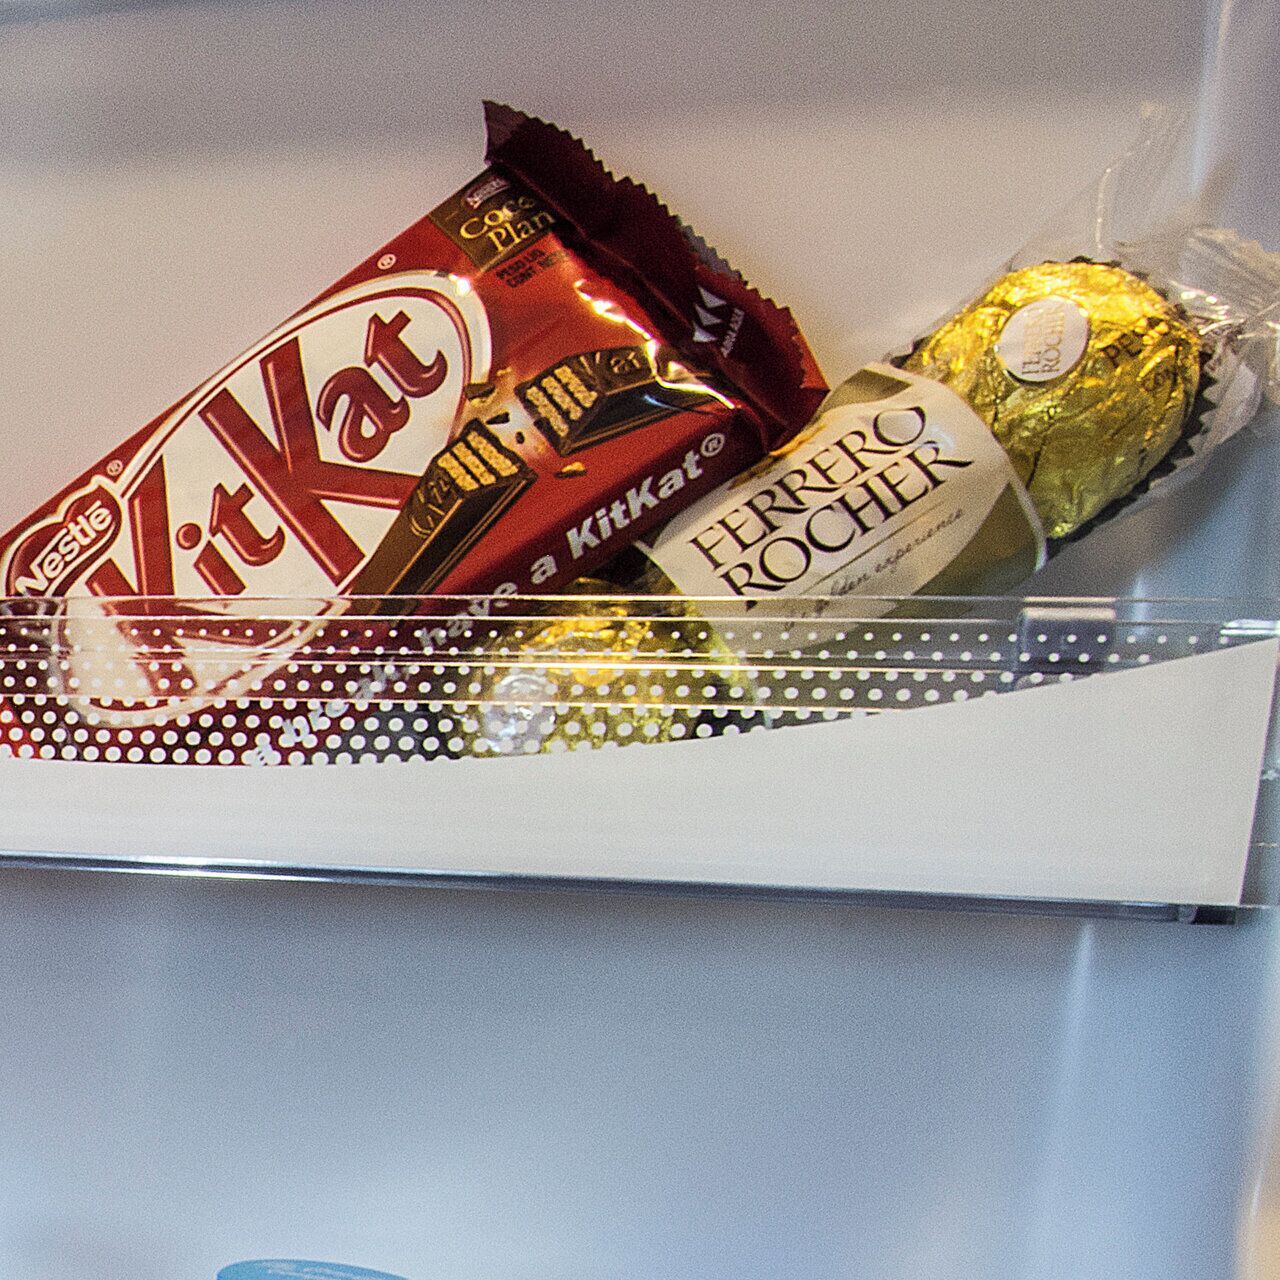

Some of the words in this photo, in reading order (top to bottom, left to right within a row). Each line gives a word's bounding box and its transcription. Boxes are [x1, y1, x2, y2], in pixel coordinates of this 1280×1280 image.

[487, 211, 555, 252] Plan
[86, 310, 448, 698] KitKat
[530, 555, 559, 584] a
[688, 405, 928, 571] FERRERO
[718, 441, 972, 612] ROCHER
